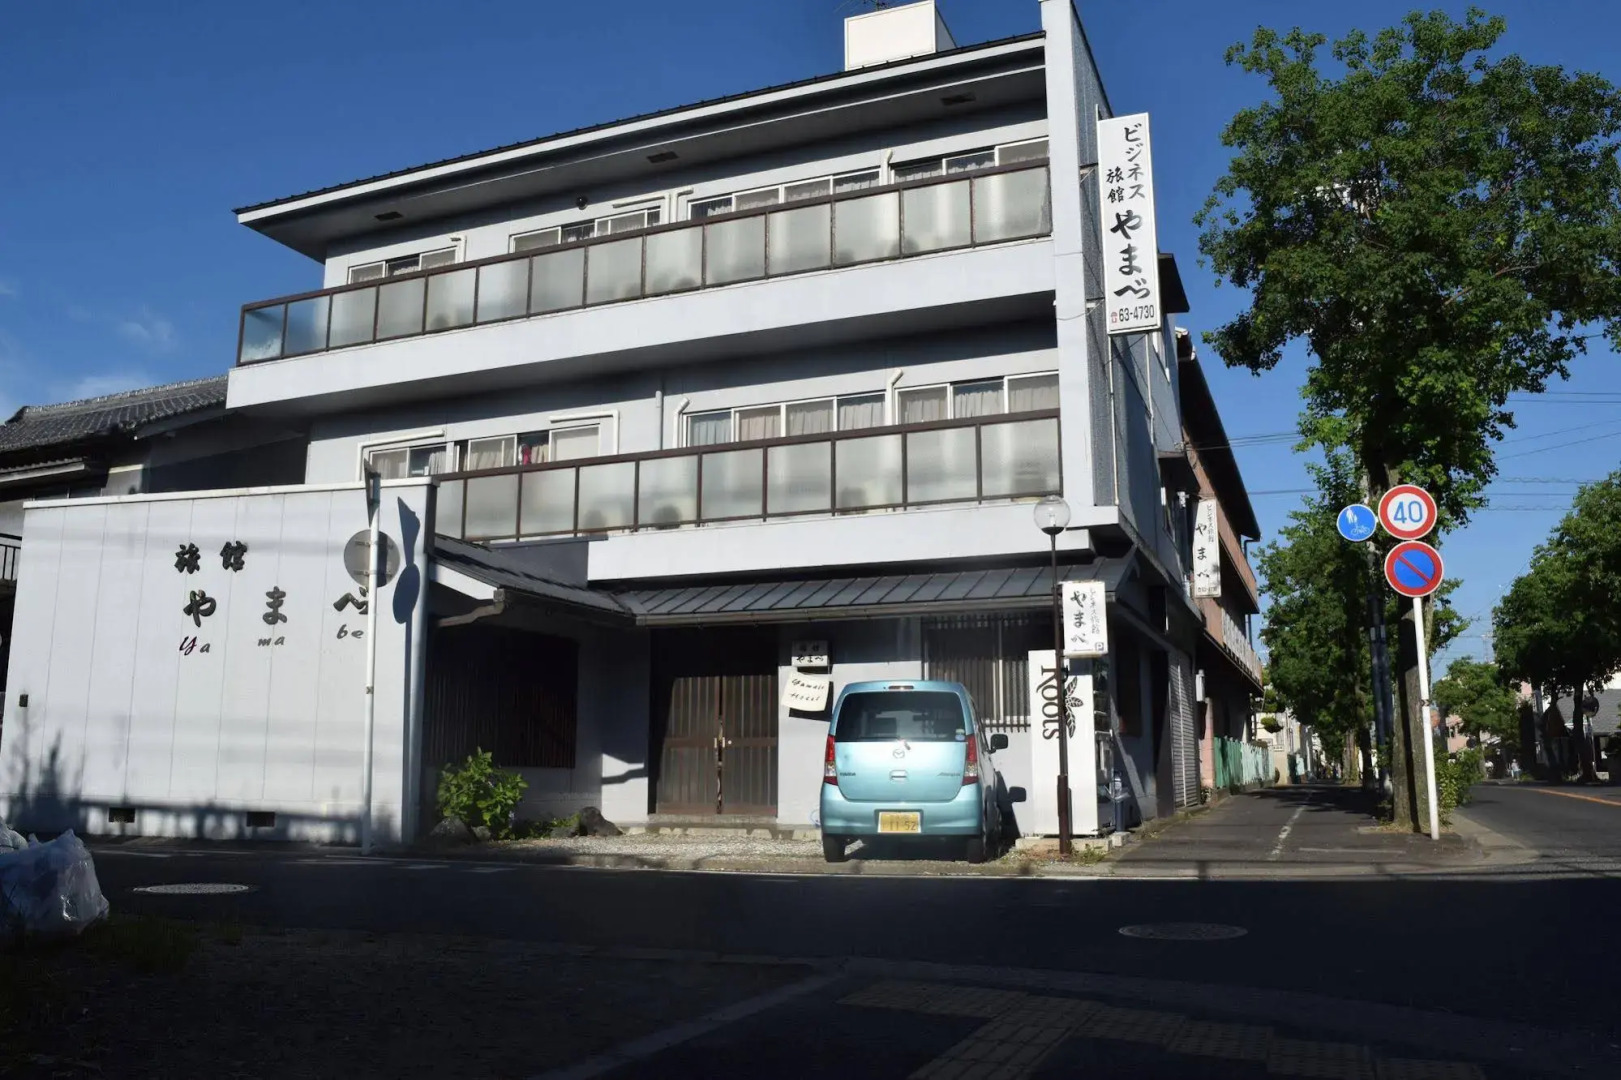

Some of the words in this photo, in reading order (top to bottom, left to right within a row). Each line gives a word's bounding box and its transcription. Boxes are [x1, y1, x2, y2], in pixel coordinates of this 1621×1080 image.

[1123, 123, 1145, 199] ビジネス
[1106, 166, 1124, 203] 旅館
[1110, 209, 1151, 299] やまべ
[1119, 304, 1155, 322] 63-4730
[1393, 501, 1423, 523] 40
[174, 541, 248, 574] 旅館
